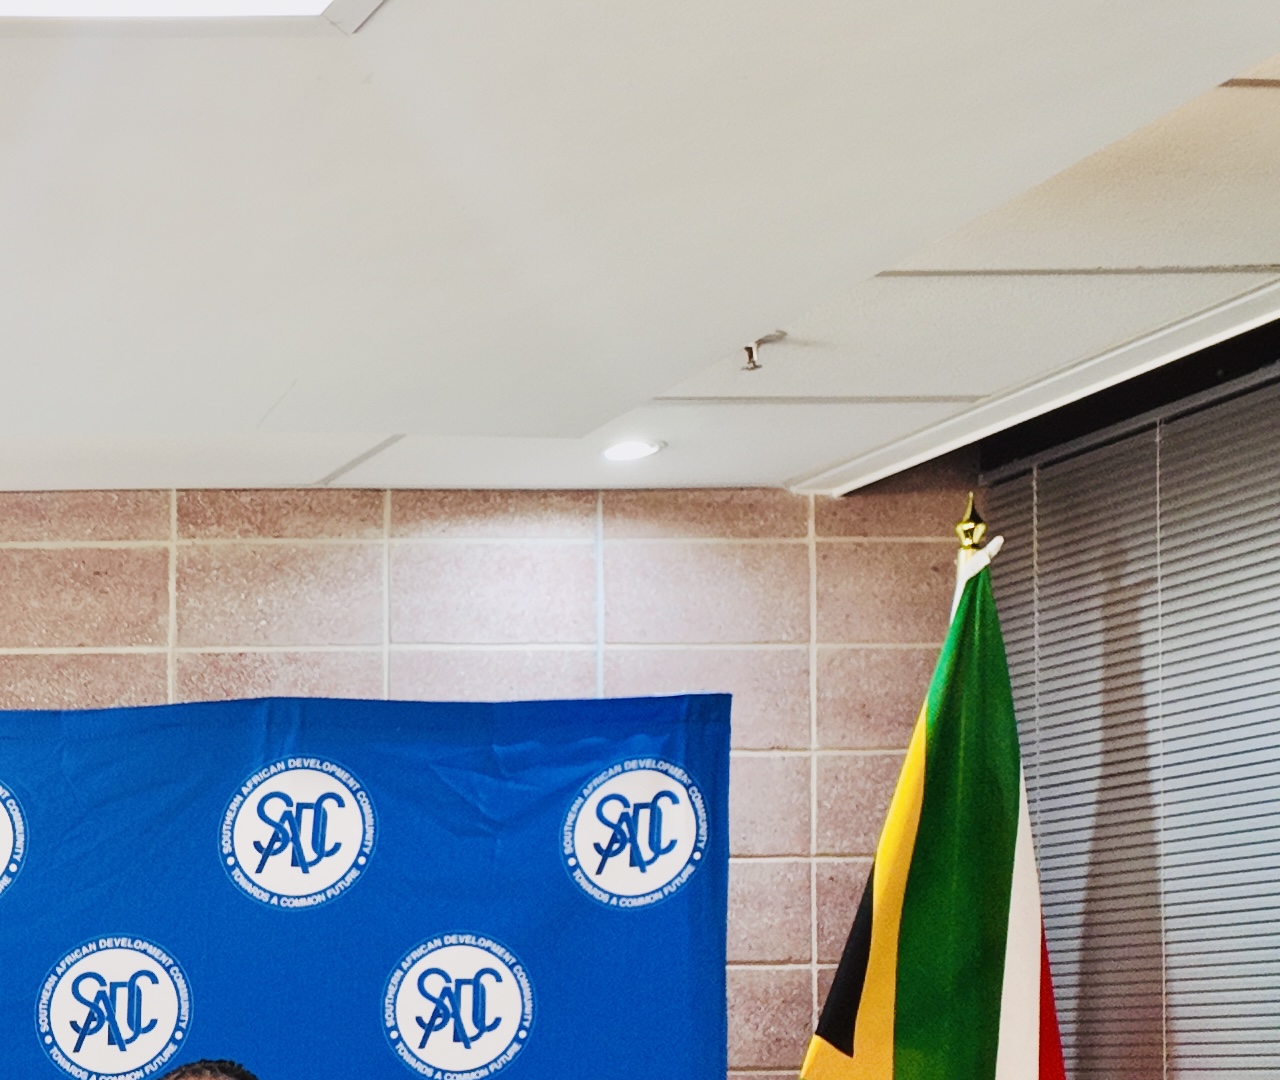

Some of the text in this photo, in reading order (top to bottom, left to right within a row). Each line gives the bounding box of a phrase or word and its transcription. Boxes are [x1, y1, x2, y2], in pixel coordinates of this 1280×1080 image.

[5, 798, 25, 862] COMMUNITY
[222, 758, 375, 854] SOUTHERN AFRICAN DEVELOPMENT COMMUNITY
[38, 938, 190, 1033] SOUTHERN AFRICAN DEVELOPMENT COMMUNITY
[384, 934, 533, 1029] SOUTHERN AFRICAN DEVELOPMENT COMMUNITY
